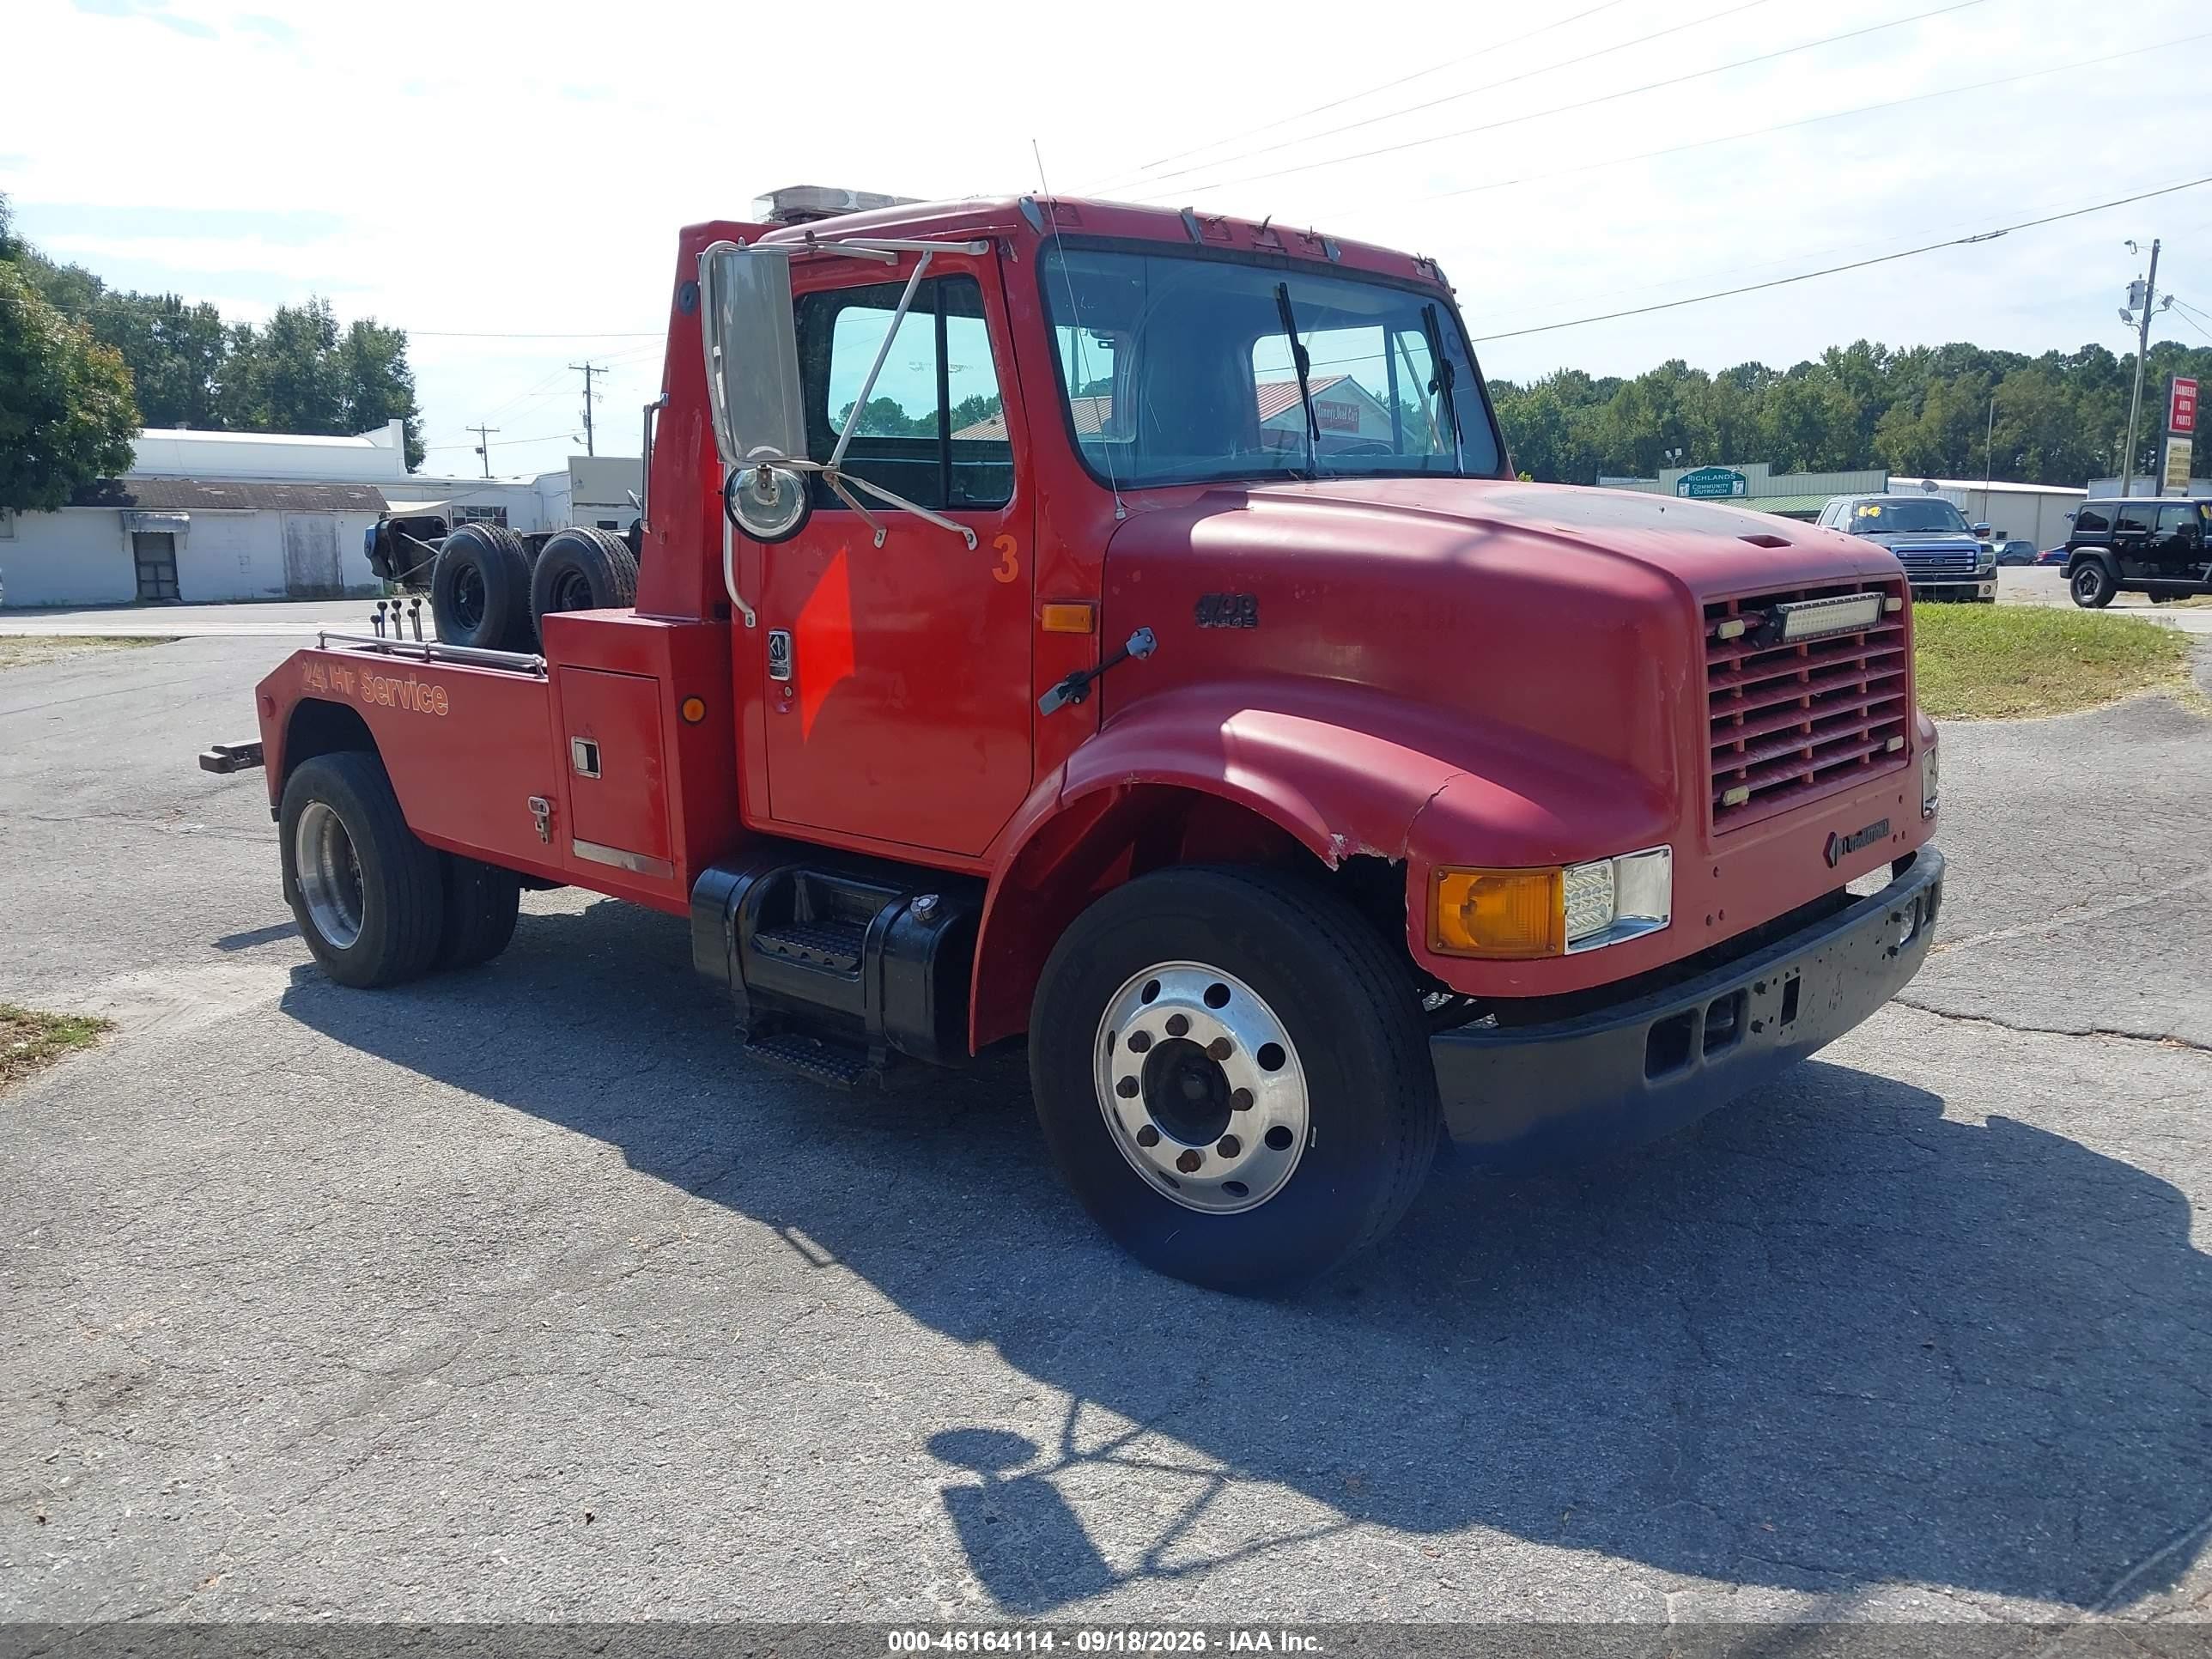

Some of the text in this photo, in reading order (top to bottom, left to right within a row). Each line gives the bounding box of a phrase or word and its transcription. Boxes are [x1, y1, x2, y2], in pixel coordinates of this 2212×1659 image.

[2179, 399, 2191, 412] AUTO
[2175, 414, 2191, 427] PARTS
[1687, 473, 1736, 482] RICHLANDS
[1858, 505, 1882, 518] 14
[992, 534, 1018, 583] 3
[358, 665, 449, 716] Service
